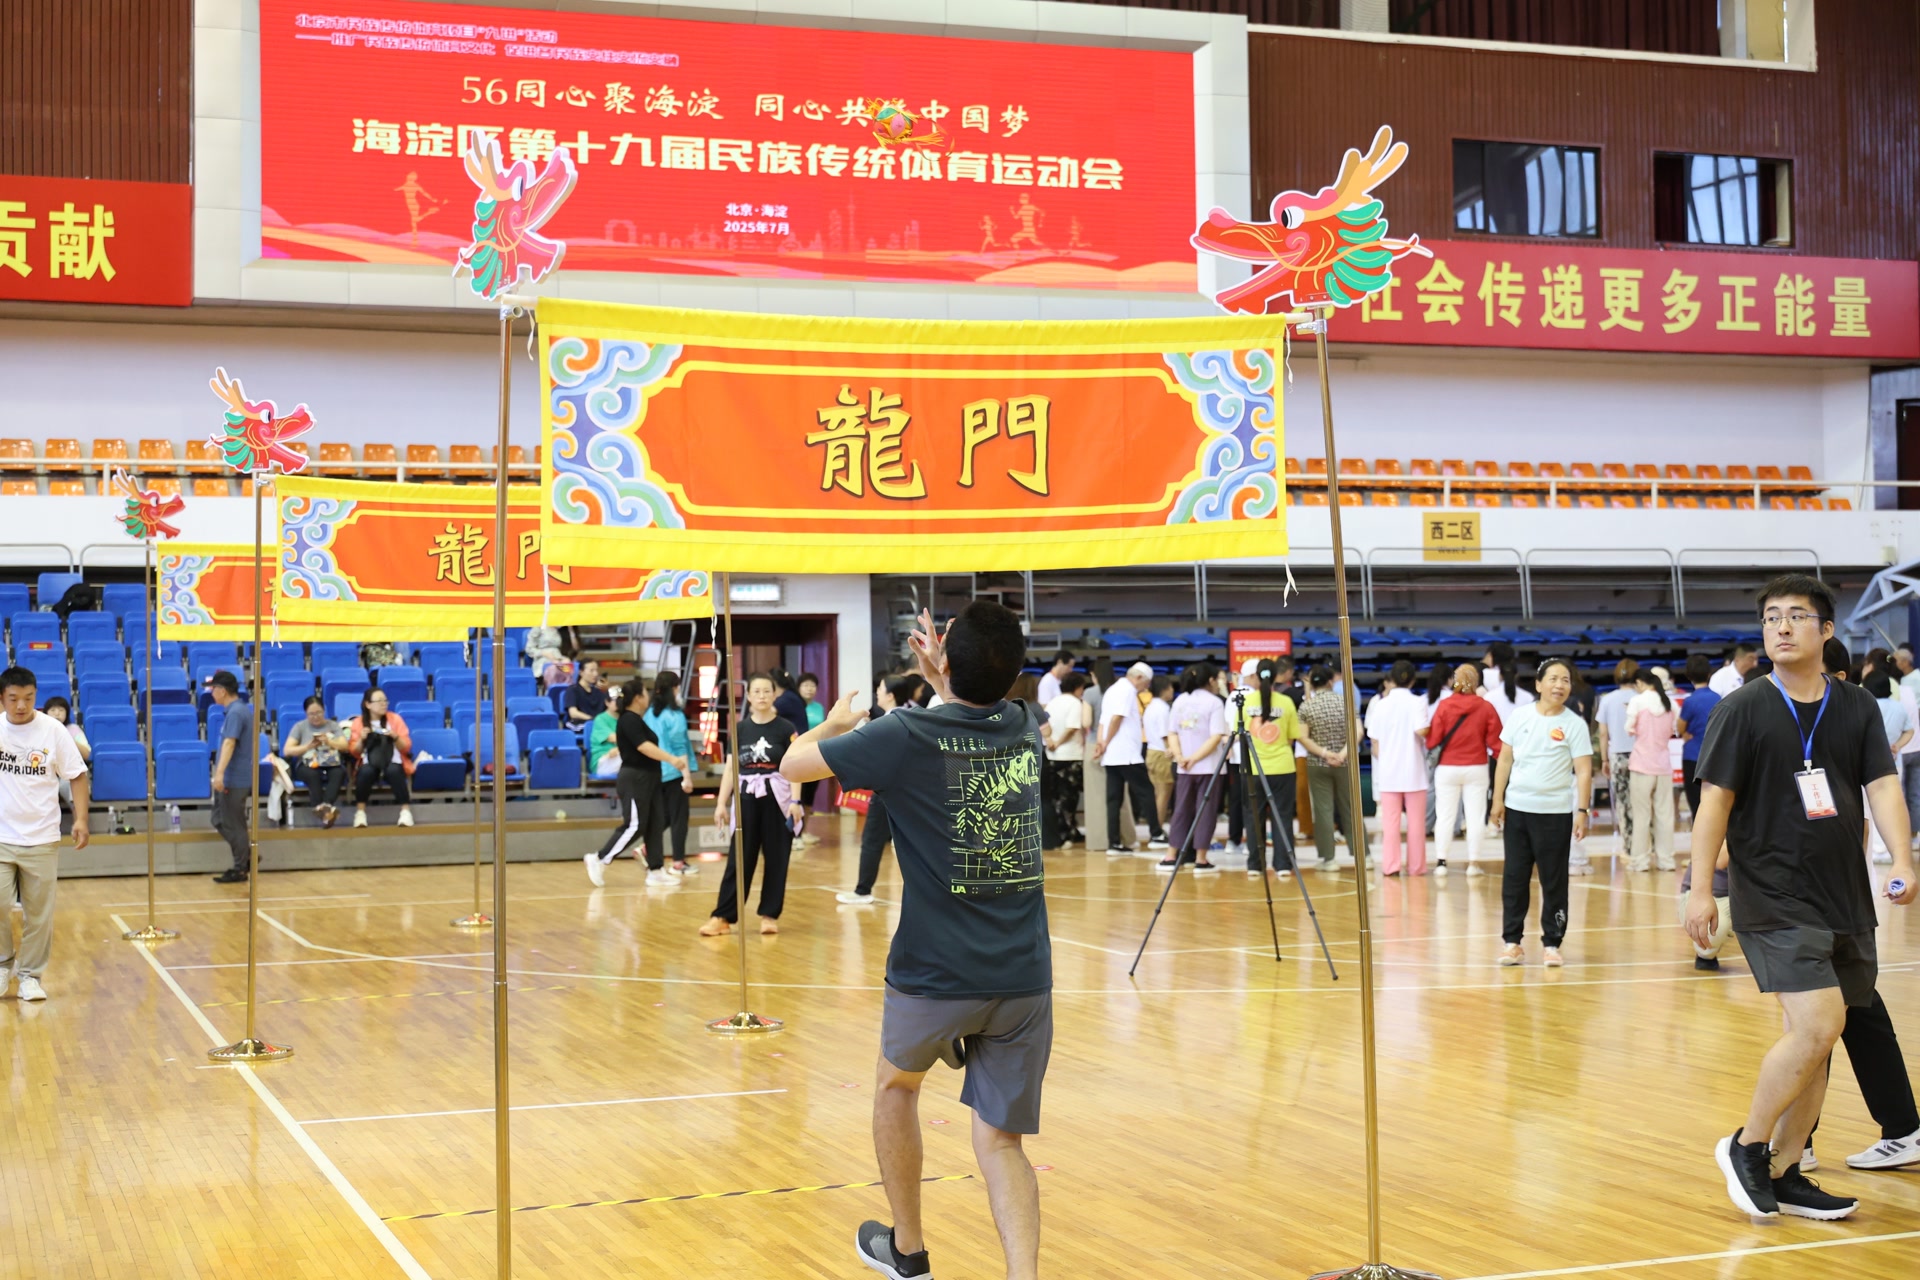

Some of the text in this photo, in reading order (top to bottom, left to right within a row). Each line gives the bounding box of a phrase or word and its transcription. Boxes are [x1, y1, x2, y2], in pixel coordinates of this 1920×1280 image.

[461, 76, 724, 119] 56同心聚海淀
[725, 203, 788, 218] 北京·海淀
[723, 220, 790, 236] 2025年7月
[1290, 258, 1873, 339] 社会传递更多正能量
[1430, 521, 1474, 540] 西二区
